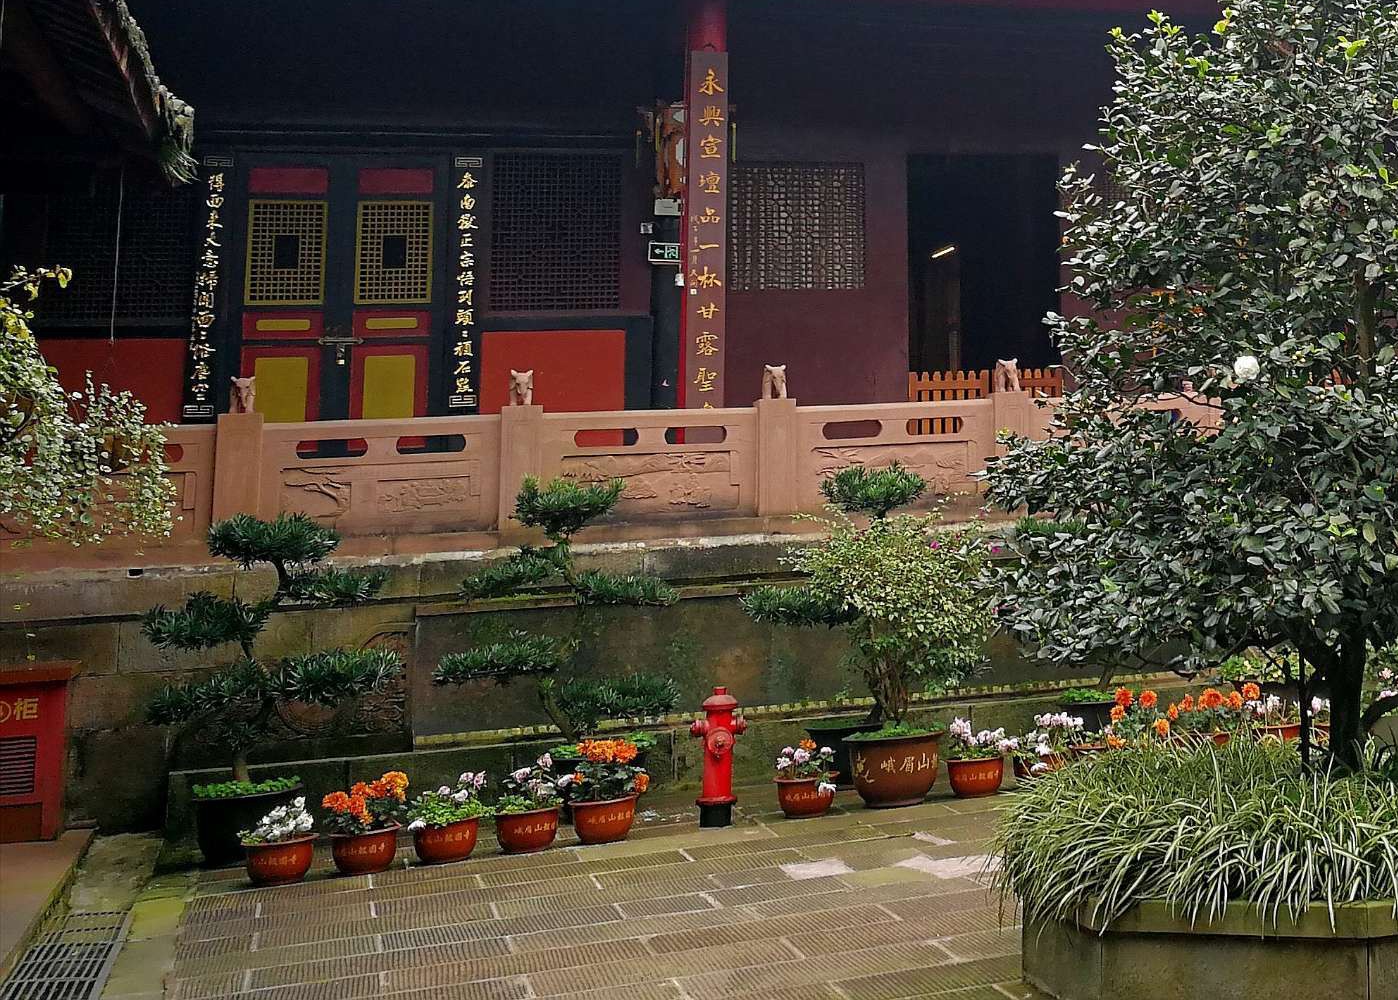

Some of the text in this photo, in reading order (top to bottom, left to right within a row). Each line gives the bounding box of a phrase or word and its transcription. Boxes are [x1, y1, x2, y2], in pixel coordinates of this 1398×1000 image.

[694, 69, 725, 408] 永興宣壇品一杯甘露聖
[14, 697, 39, 721] 柜
